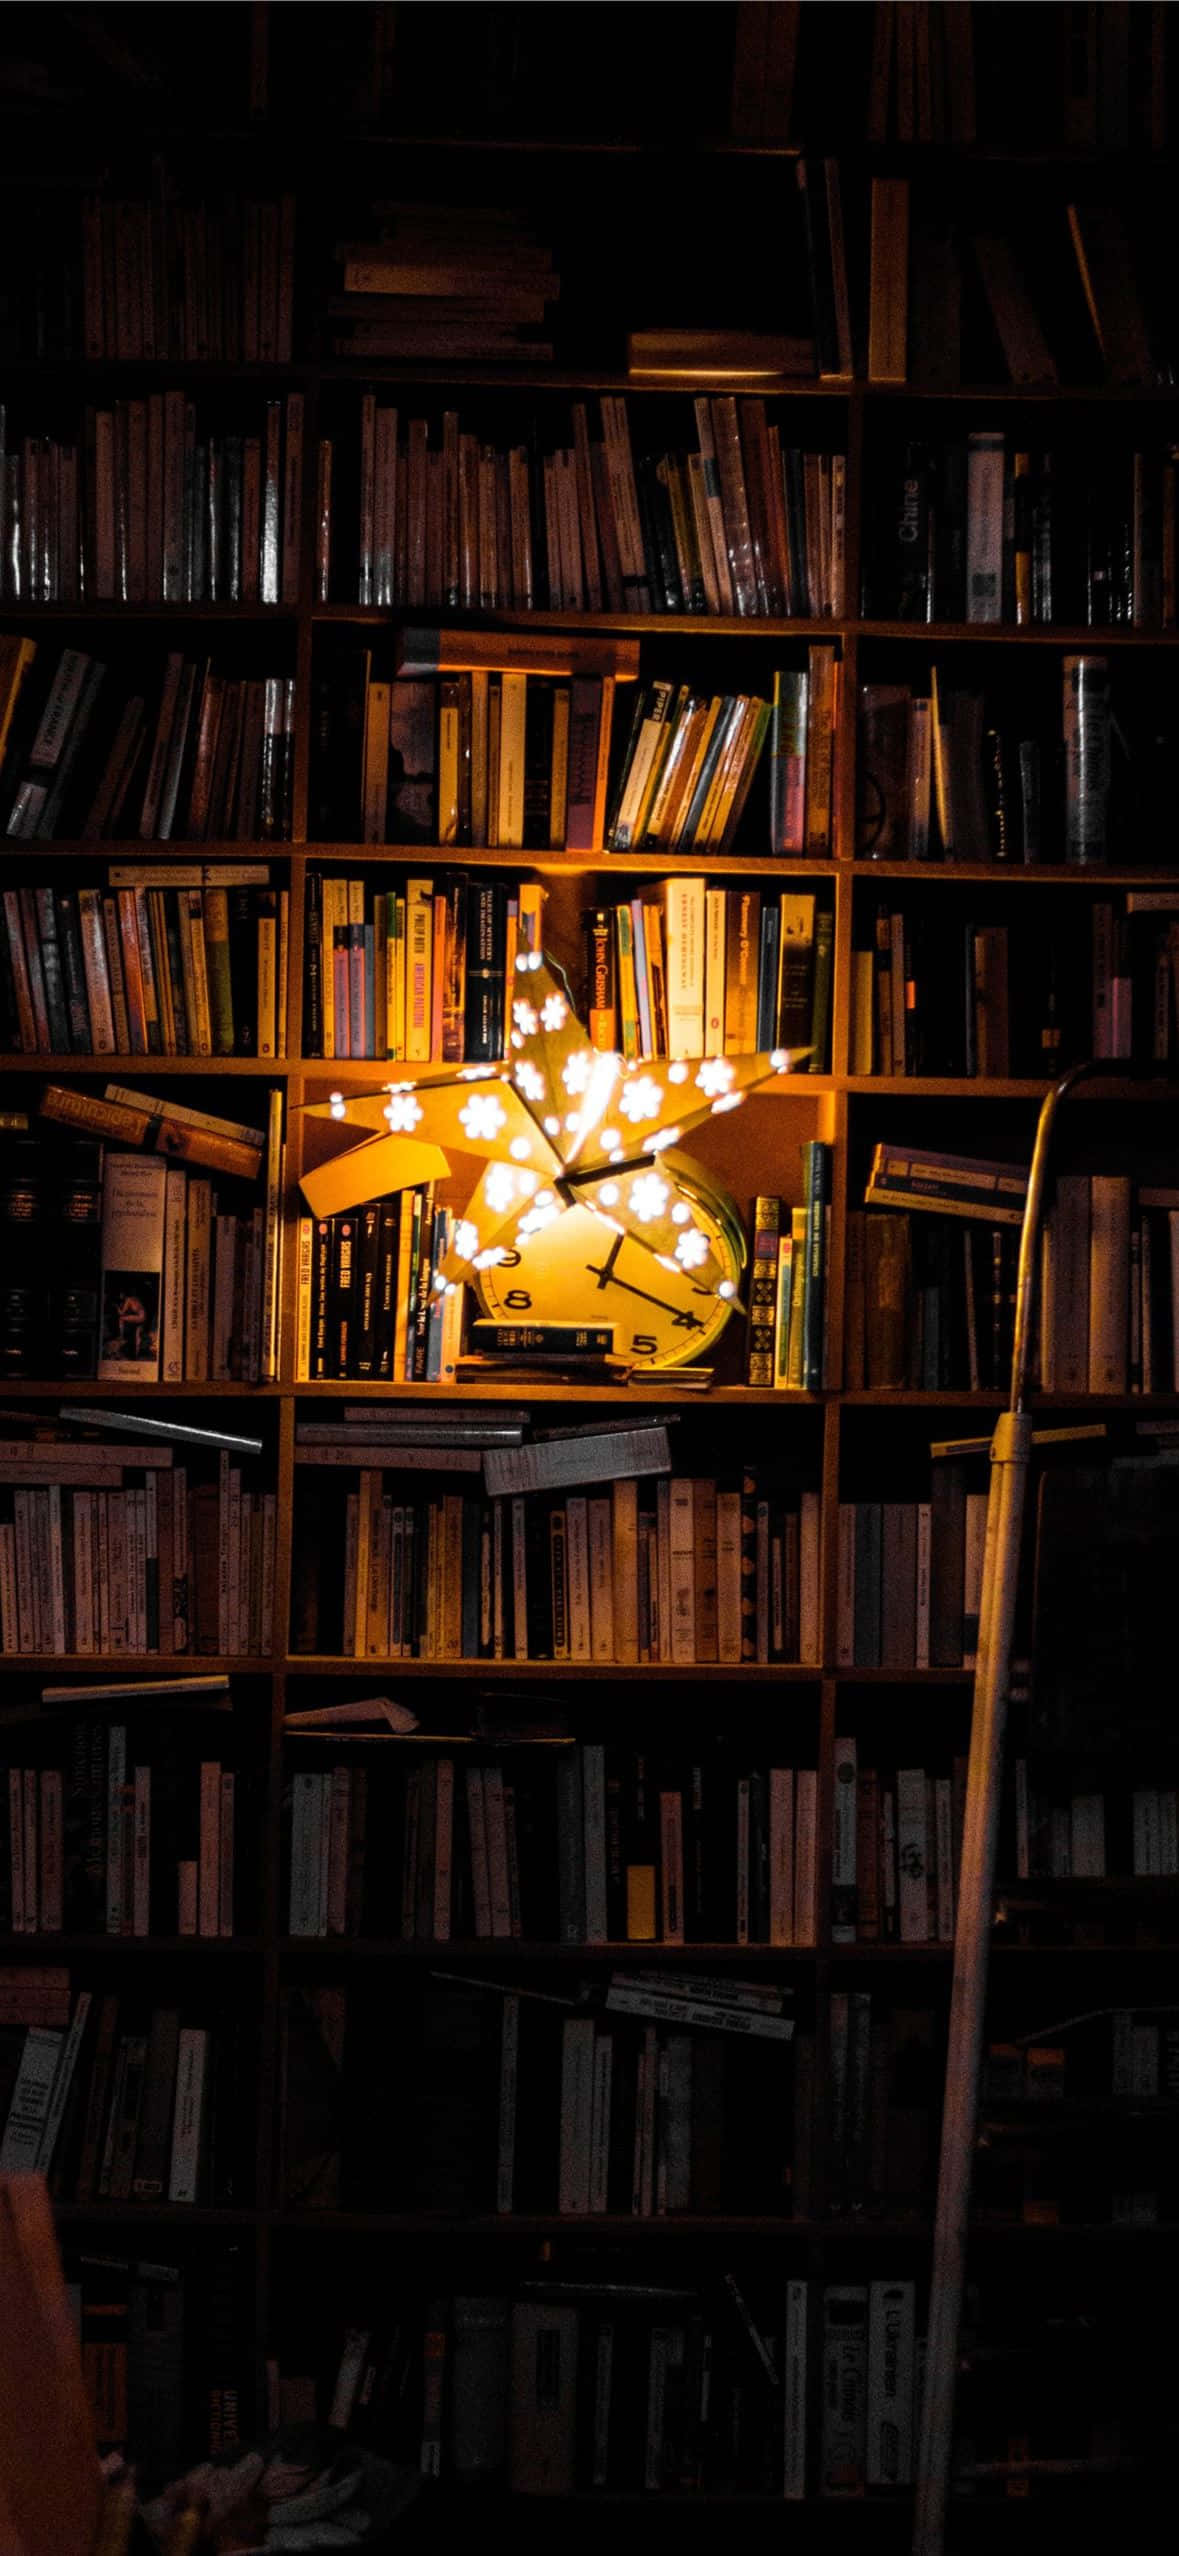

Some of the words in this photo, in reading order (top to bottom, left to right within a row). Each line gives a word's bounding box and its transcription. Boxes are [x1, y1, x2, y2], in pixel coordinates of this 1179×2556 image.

[897, 480, 920, 544] Chine
[650, 689, 668, 721] PIPER
[479, 891, 487, 907] AND
[486, 914, 493, 924] OF
[739, 895, 751, 937] Flannery
[479, 909, 487, 961] IMAGINATION
[595, 937, 606, 963] JOHN
[740, 940, 751, 985] O'Connor
[595, 964, 608, 1009] GRISHAM
[302, 1240, 311, 1266] VARGAS
[340, 1240, 352, 1268] VARGAS
[301, 1268, 310, 1285] FRED
[340, 1270, 351, 1288] FRED
[420, 1258, 431, 1281] langue
[503, 1289, 532, 1310] 8
[671, 1311, 701, 1331] 4
[630, 1335, 657, 1355] 5
[416, 1345, 424, 1374] FAVRE
